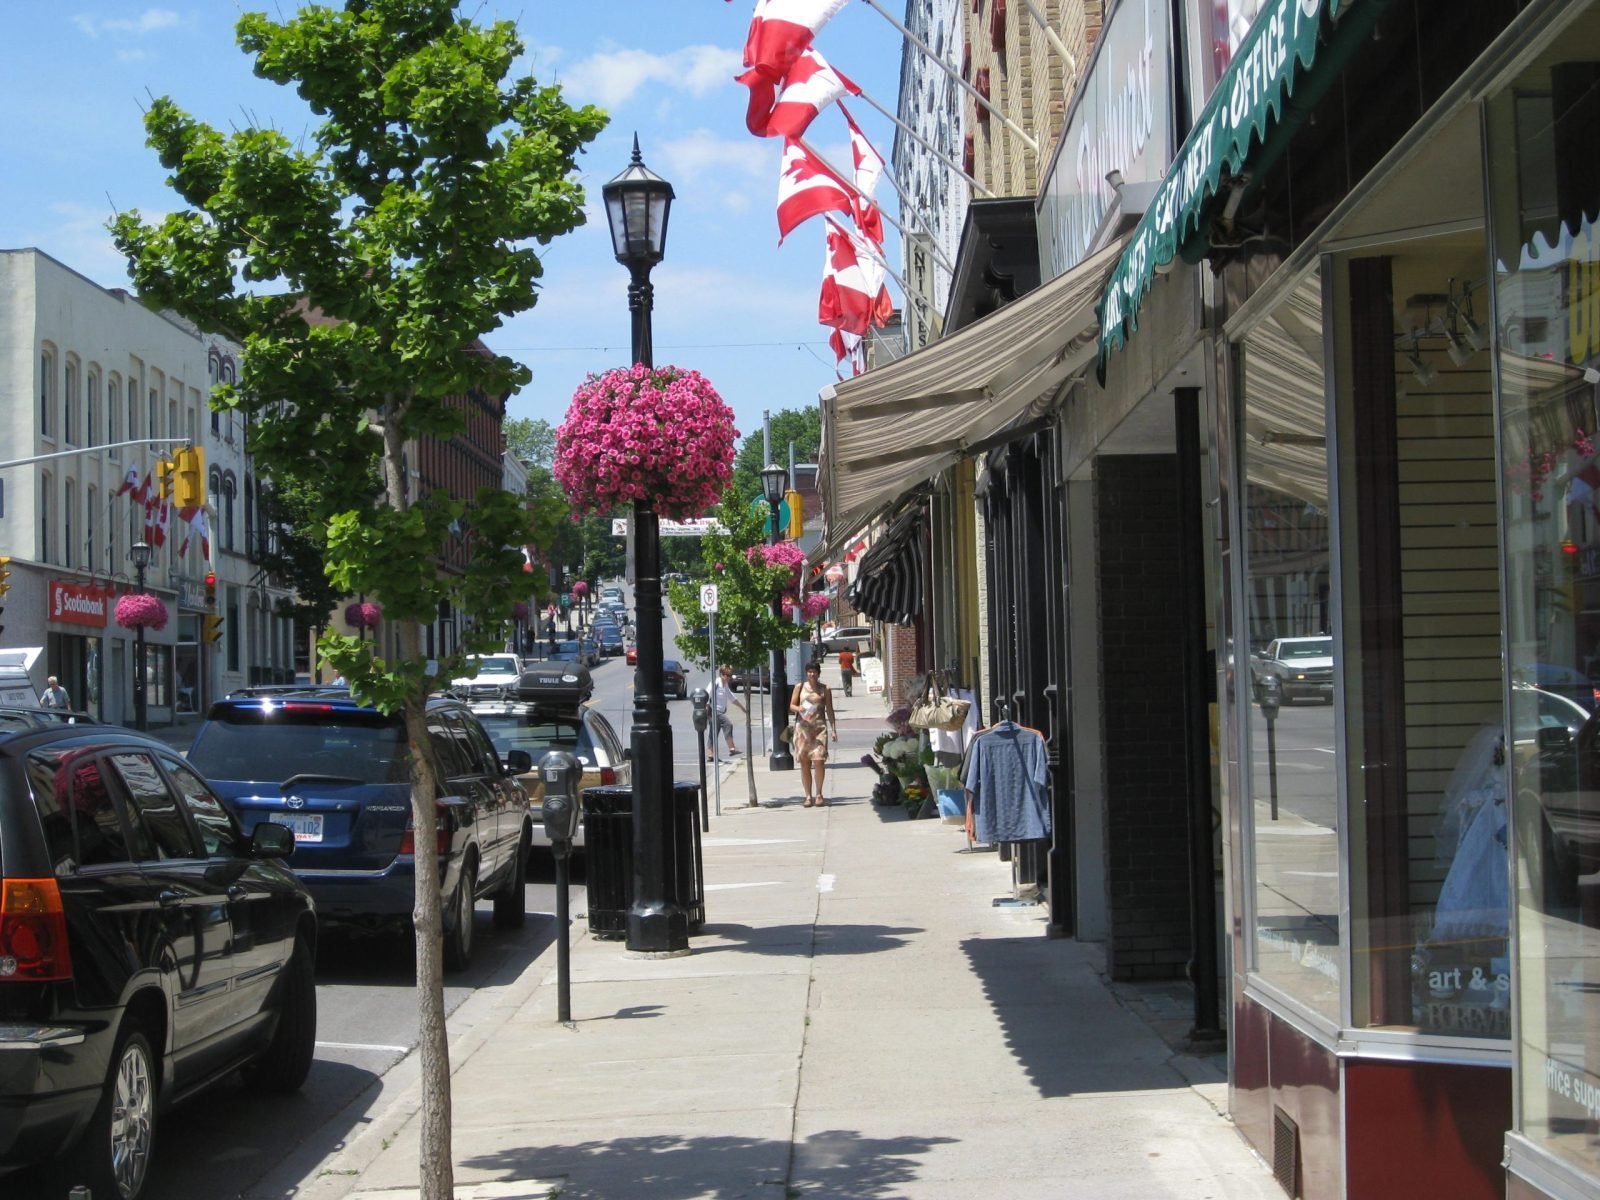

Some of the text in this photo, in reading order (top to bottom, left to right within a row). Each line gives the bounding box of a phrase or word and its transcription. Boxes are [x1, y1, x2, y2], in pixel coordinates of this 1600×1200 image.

[1230, 0, 1287, 129] OFFICE
[64, 592, 104, 616] Scotiabank
[1428, 967, 1461, 990] art
[1468, 967, 1487, 991] &
